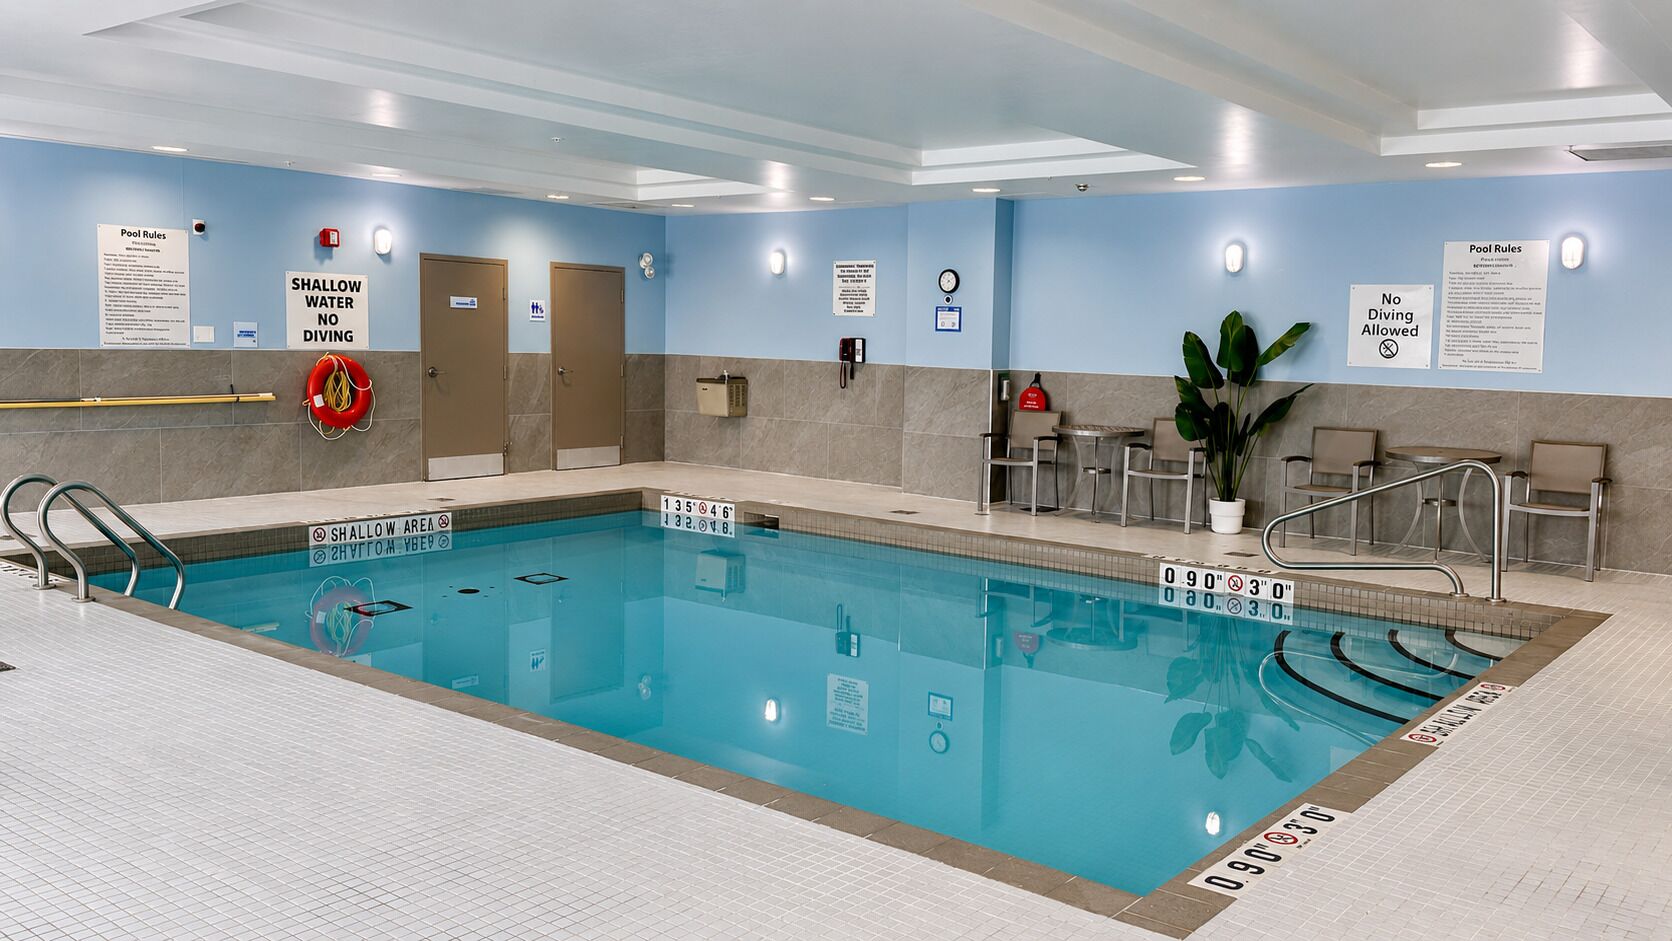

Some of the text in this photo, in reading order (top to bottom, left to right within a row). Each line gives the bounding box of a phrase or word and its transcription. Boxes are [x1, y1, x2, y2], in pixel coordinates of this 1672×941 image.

[121, 228, 167, 240] Pool Rules
[1469, 243, 1522, 254] Pool Rules
[291, 277, 362, 293] SHALLOW
[305, 295, 354, 309] WATER
[1381, 293, 1402, 305] No
[318, 313, 339, 326] NO
[1368, 308, 1413, 324] Diving
[303, 330, 354, 342] DIVING
[1361, 323, 1419, 337] Allowed
[330, 517, 434, 542] SHALLOW AREA
